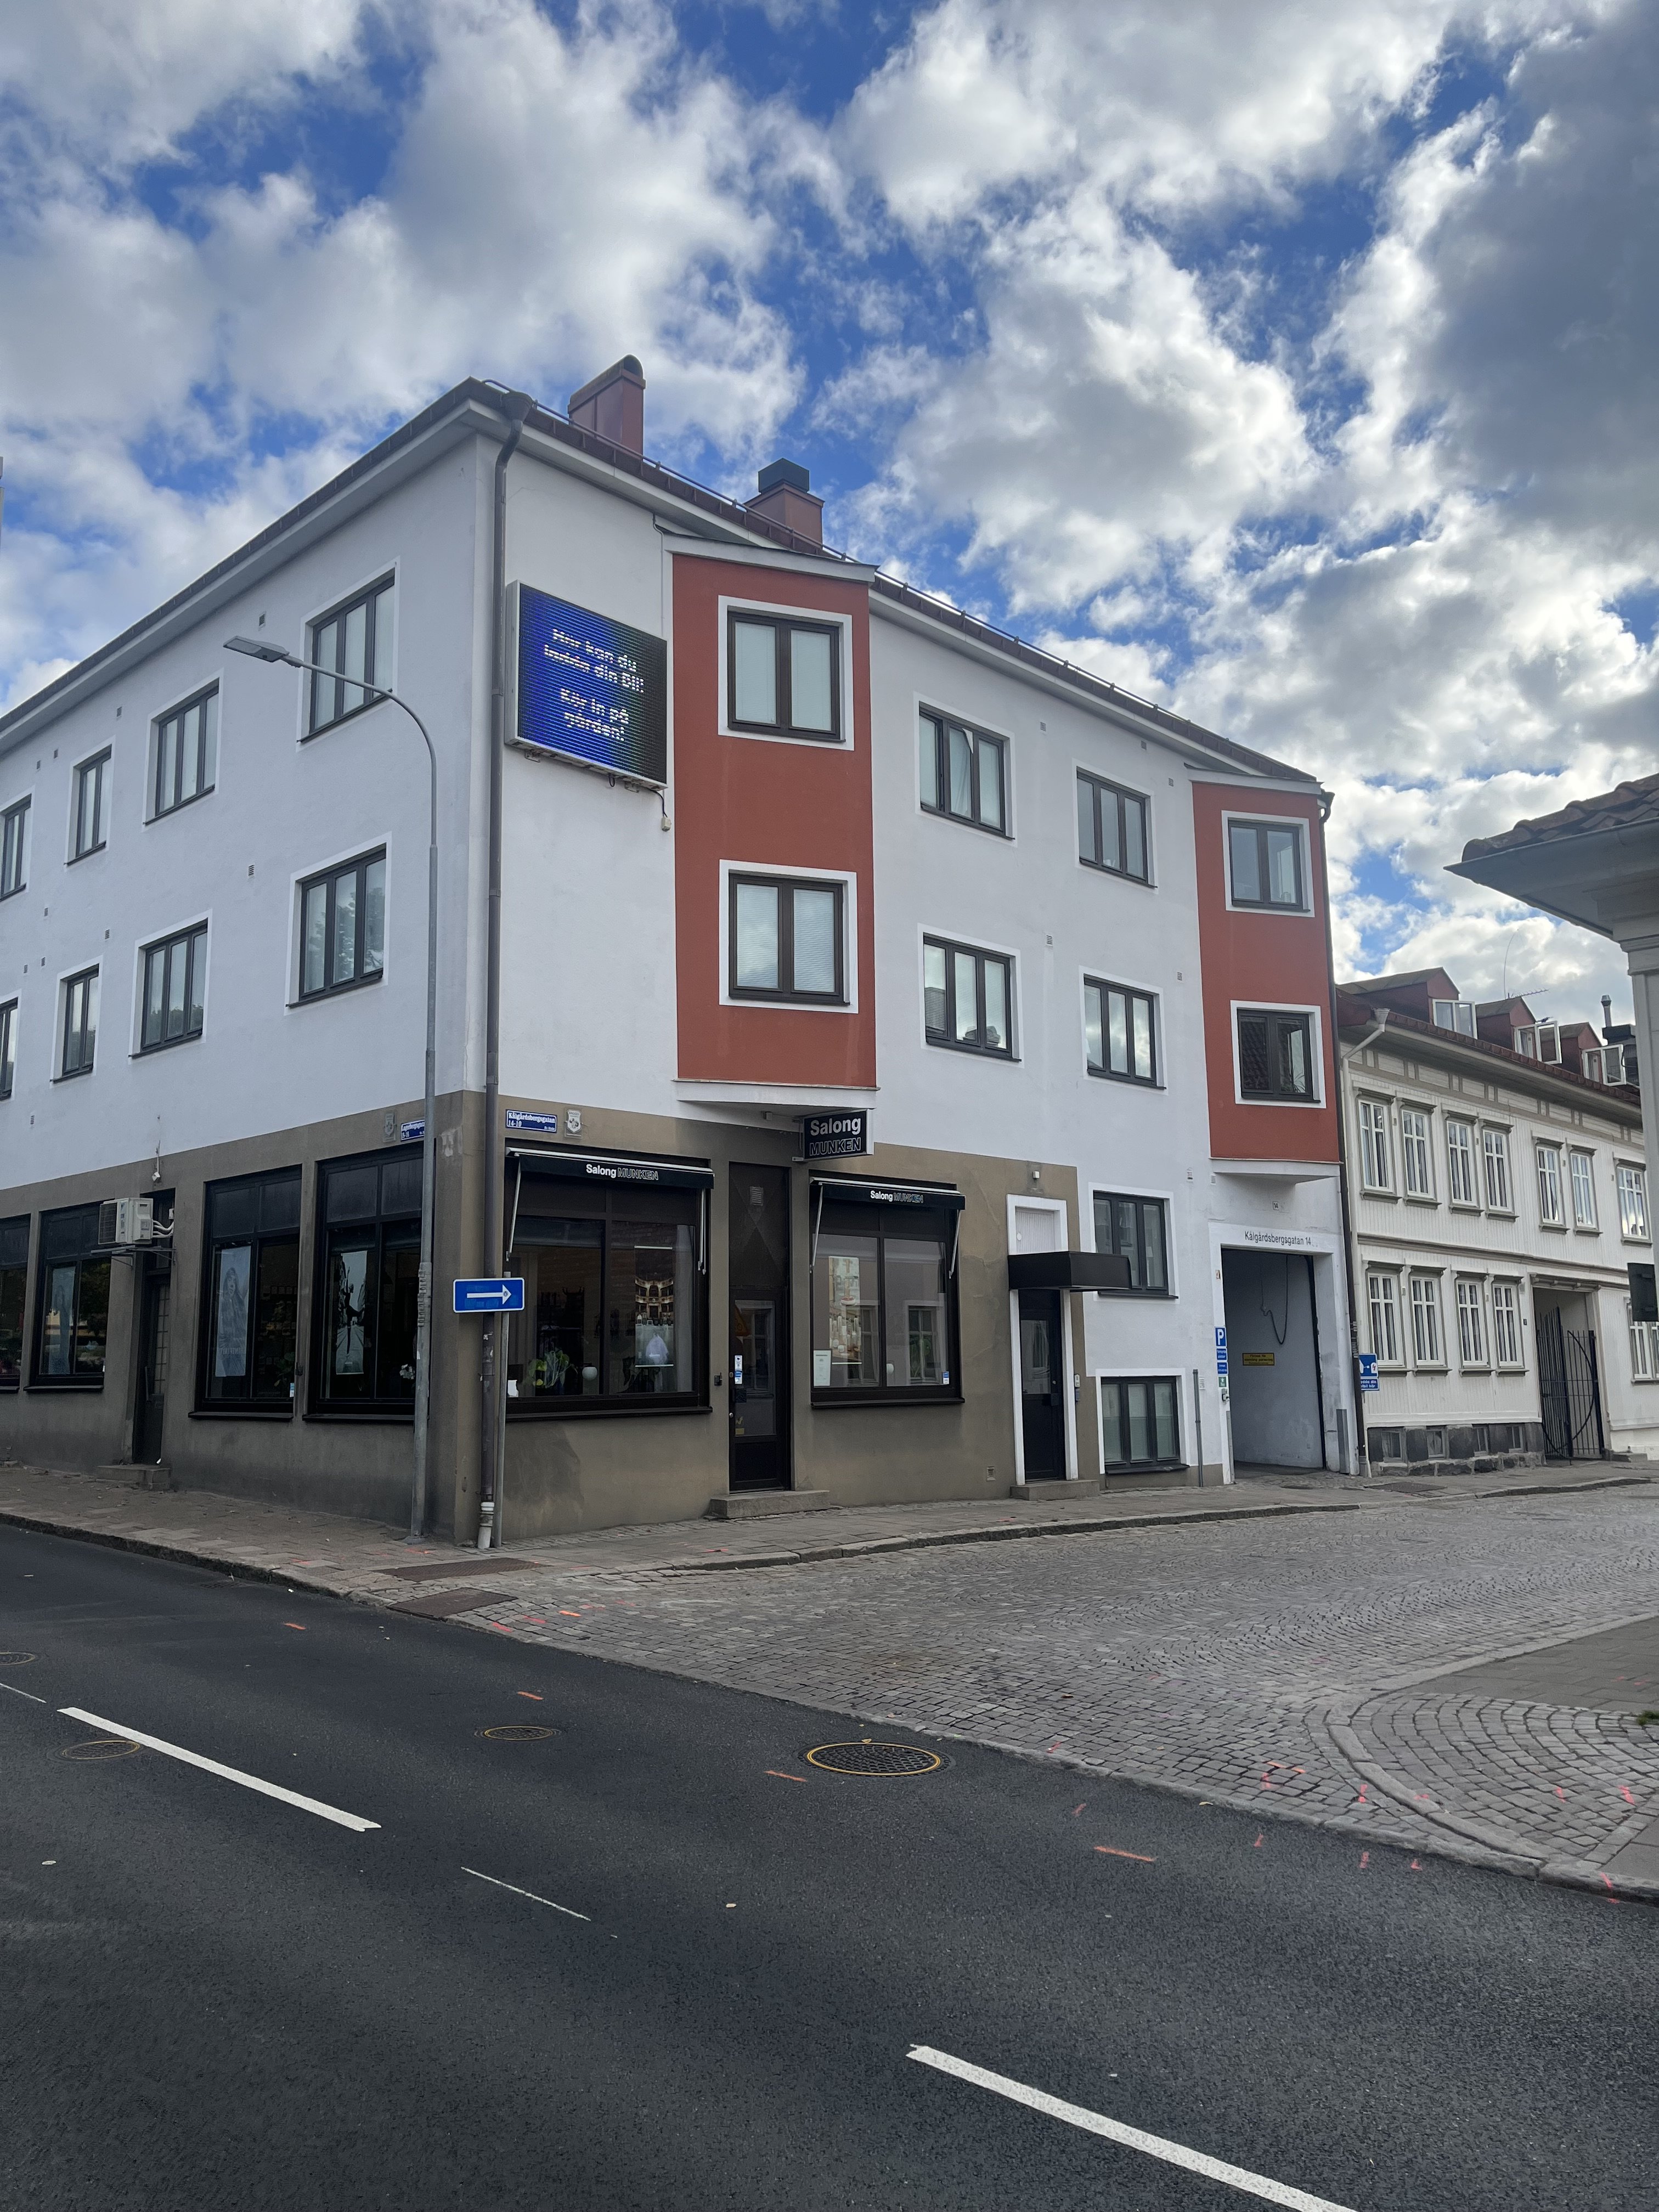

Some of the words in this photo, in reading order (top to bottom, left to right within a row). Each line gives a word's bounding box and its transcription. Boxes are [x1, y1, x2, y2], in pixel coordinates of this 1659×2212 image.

[810, 1118, 861, 1136] Salong
[809, 1137, 861, 1156] MUNKEN
[586, 1164, 617, 1178] Salong
[617, 1167, 659, 1180] MUNKEN
[870, 1190, 893, 1202] Salong
[893, 1192, 924, 1204] MUNKEN
[1244, 1231, 1304, 1246] Kålgårdsbergsgatan
[1217, 1328, 1224, 1345] P
